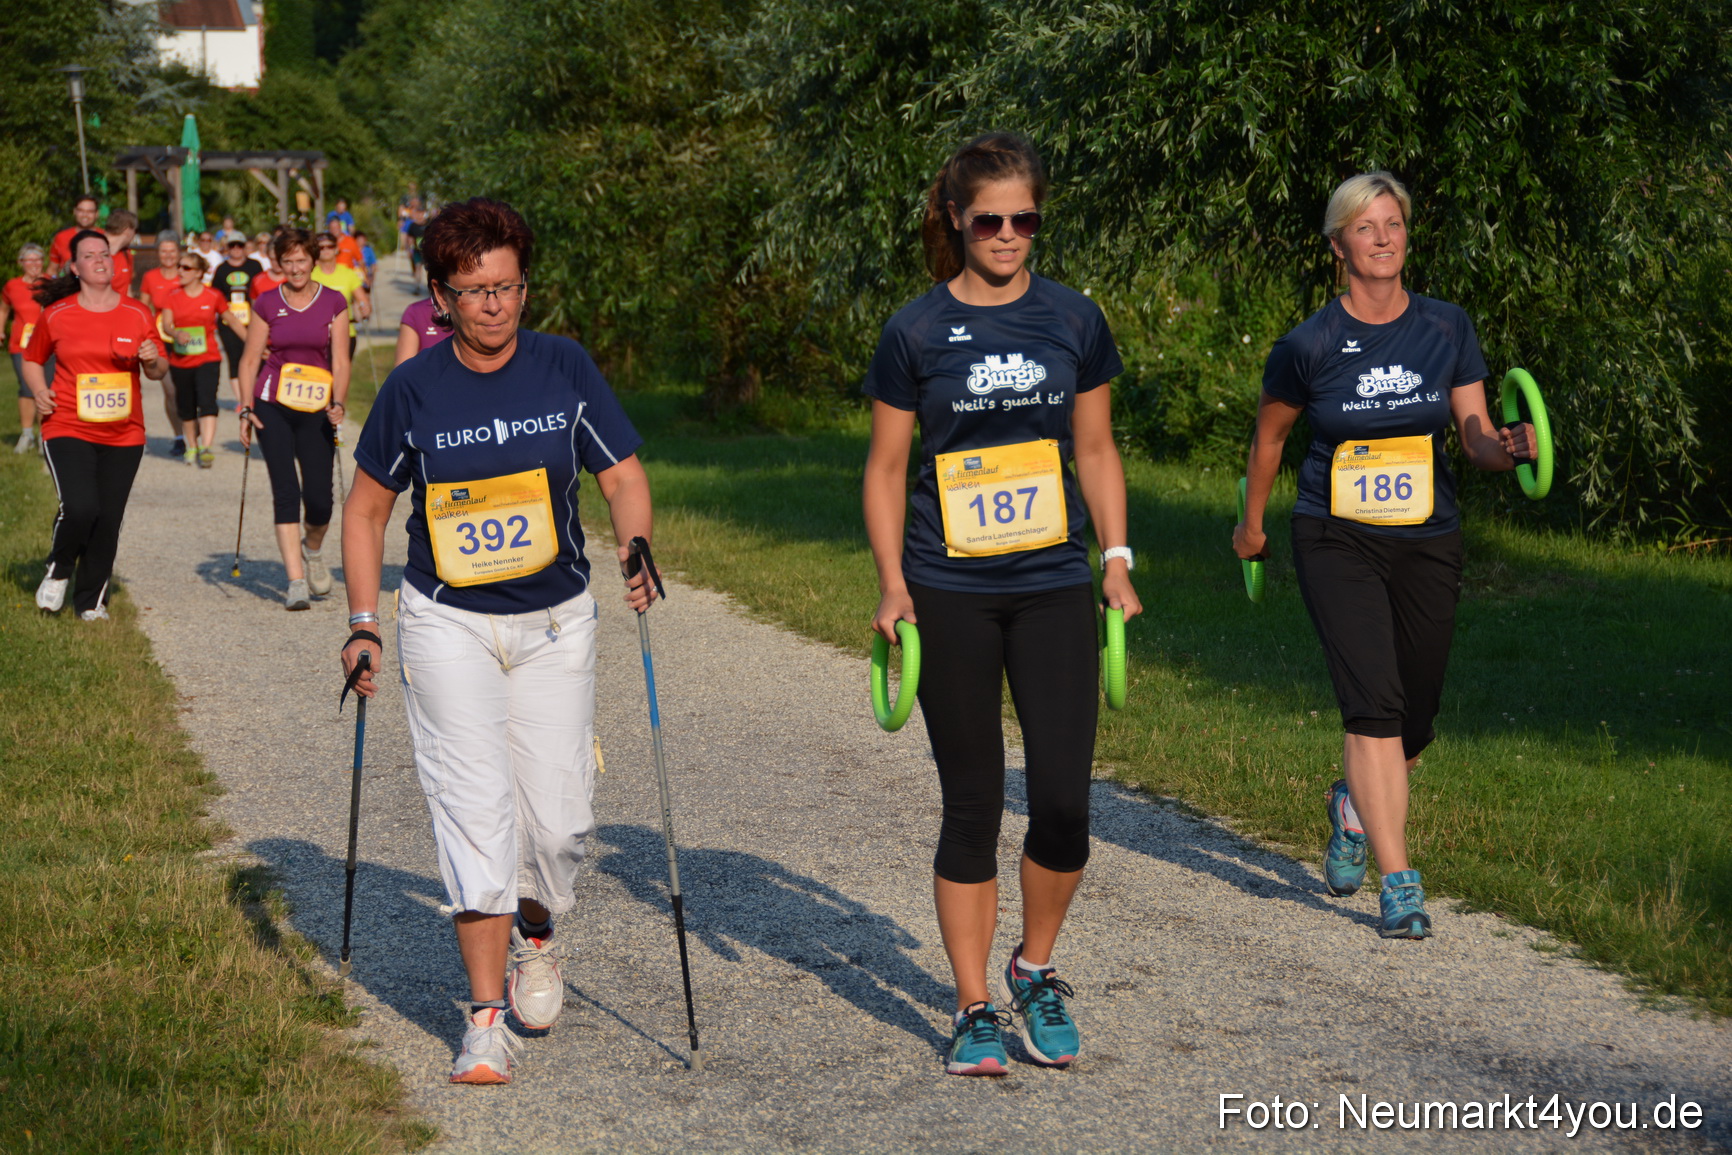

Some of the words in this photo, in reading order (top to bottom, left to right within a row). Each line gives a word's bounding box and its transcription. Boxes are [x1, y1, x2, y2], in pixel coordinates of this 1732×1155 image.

[948, 334, 972, 342] erima
[967, 359, 1047, 395] Burgis
[1356, 370, 1422, 398] Burgis
[84, 392, 126, 408] 1055
[285, 382, 325, 400] 1113
[952, 397, 996, 412] Weil's
[1002, 391, 1042, 411] guad
[1048, 391, 1064, 404] is!
[1342, 399, 1381, 412] Weil's
[1387, 392, 1422, 410] guad
[1426, 391, 1440, 402] is!
[435, 426, 491, 449] EURO
[511, 412, 567, 437] POLES
[1347, 452, 1382, 461] firmenlauf
[957, 465, 999, 478] firmenlauf
[1354, 472, 1413, 502] 186
[444, 495, 487, 508] firmenlauf
[968, 486, 1038, 527] 187
[456, 514, 532, 555] 392
[966, 534, 992, 544] Sandra
[993, 526, 1048, 540] Lautenschlager
[471, 560, 492, 569] Heike
[493, 556, 524, 566] Nennker
